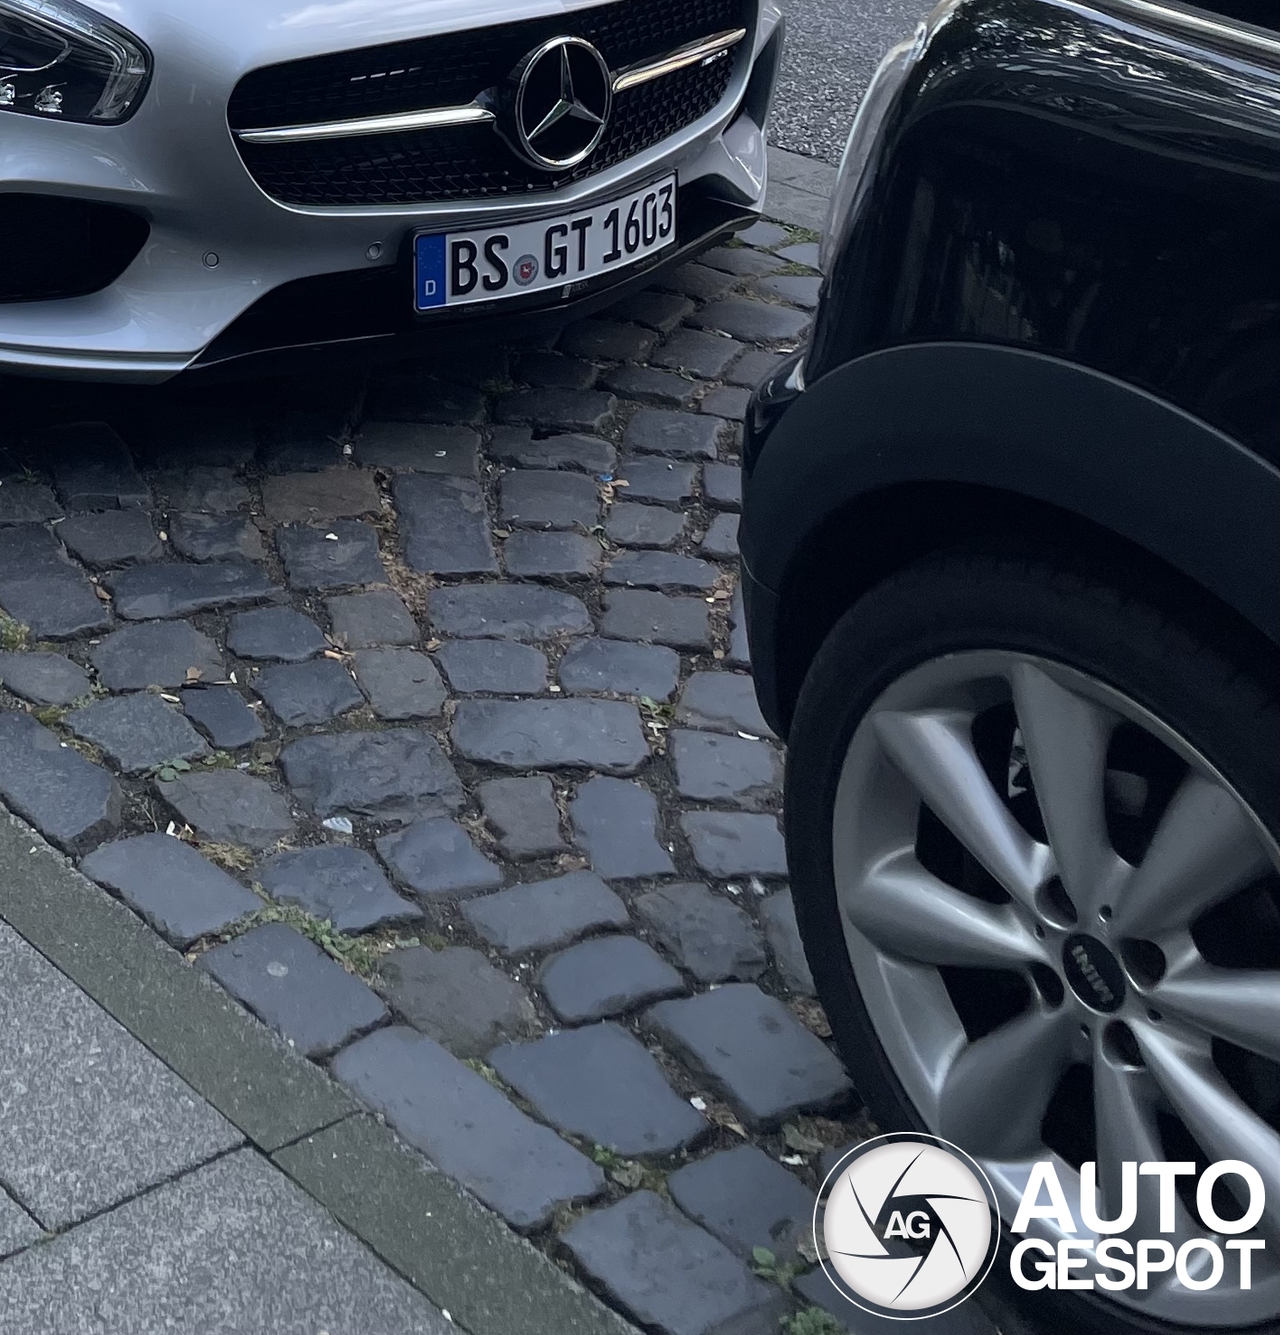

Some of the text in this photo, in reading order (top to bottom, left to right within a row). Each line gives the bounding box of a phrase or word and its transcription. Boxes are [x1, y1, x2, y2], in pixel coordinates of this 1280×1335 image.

[451, 183, 673, 296] BS GT 1603
[425, 279, 436, 296] D
